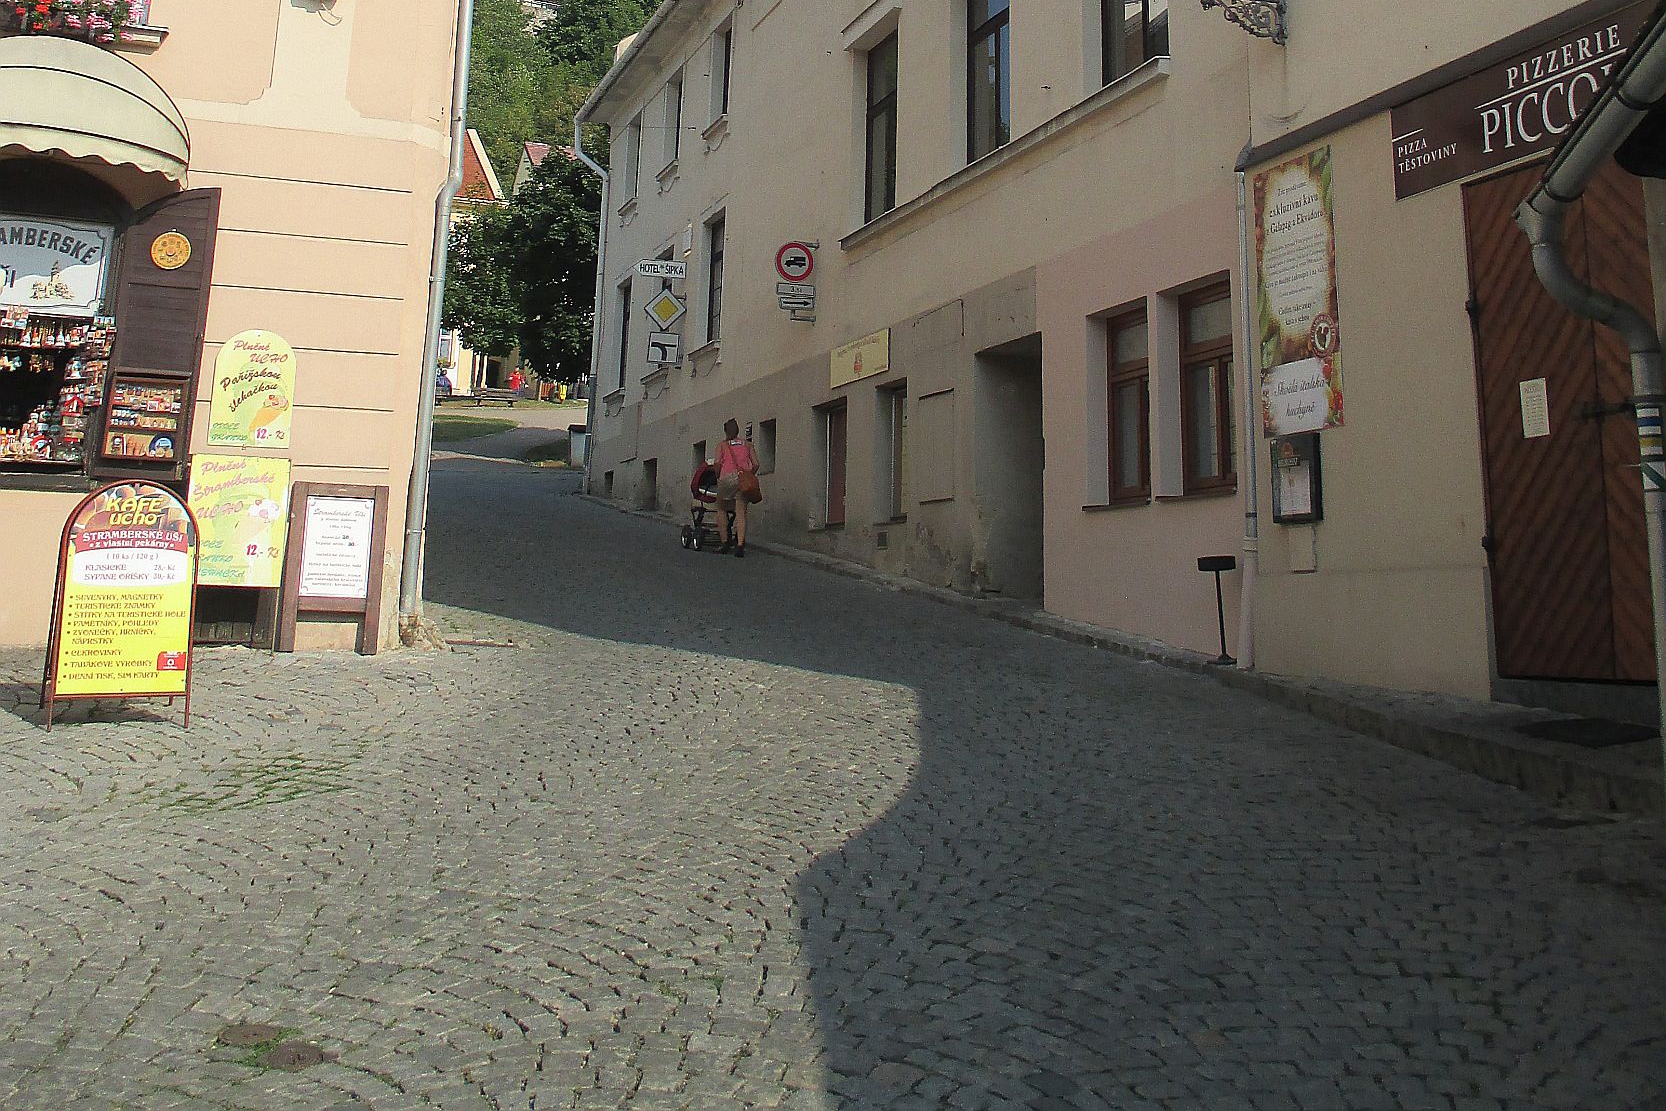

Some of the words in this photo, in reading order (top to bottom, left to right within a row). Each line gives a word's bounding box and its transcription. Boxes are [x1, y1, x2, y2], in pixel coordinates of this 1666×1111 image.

[1507, 24, 1620, 90] PIZZERIE
[1398, 138, 1427, 157] PIZZA
[640, 264, 660, 273] HOTEL
[105, 496, 164, 512] KAFE
[109, 512, 160, 525] ucho
[102, 539, 133, 547] vlastní
[135, 540, 170, 549] pekárny
